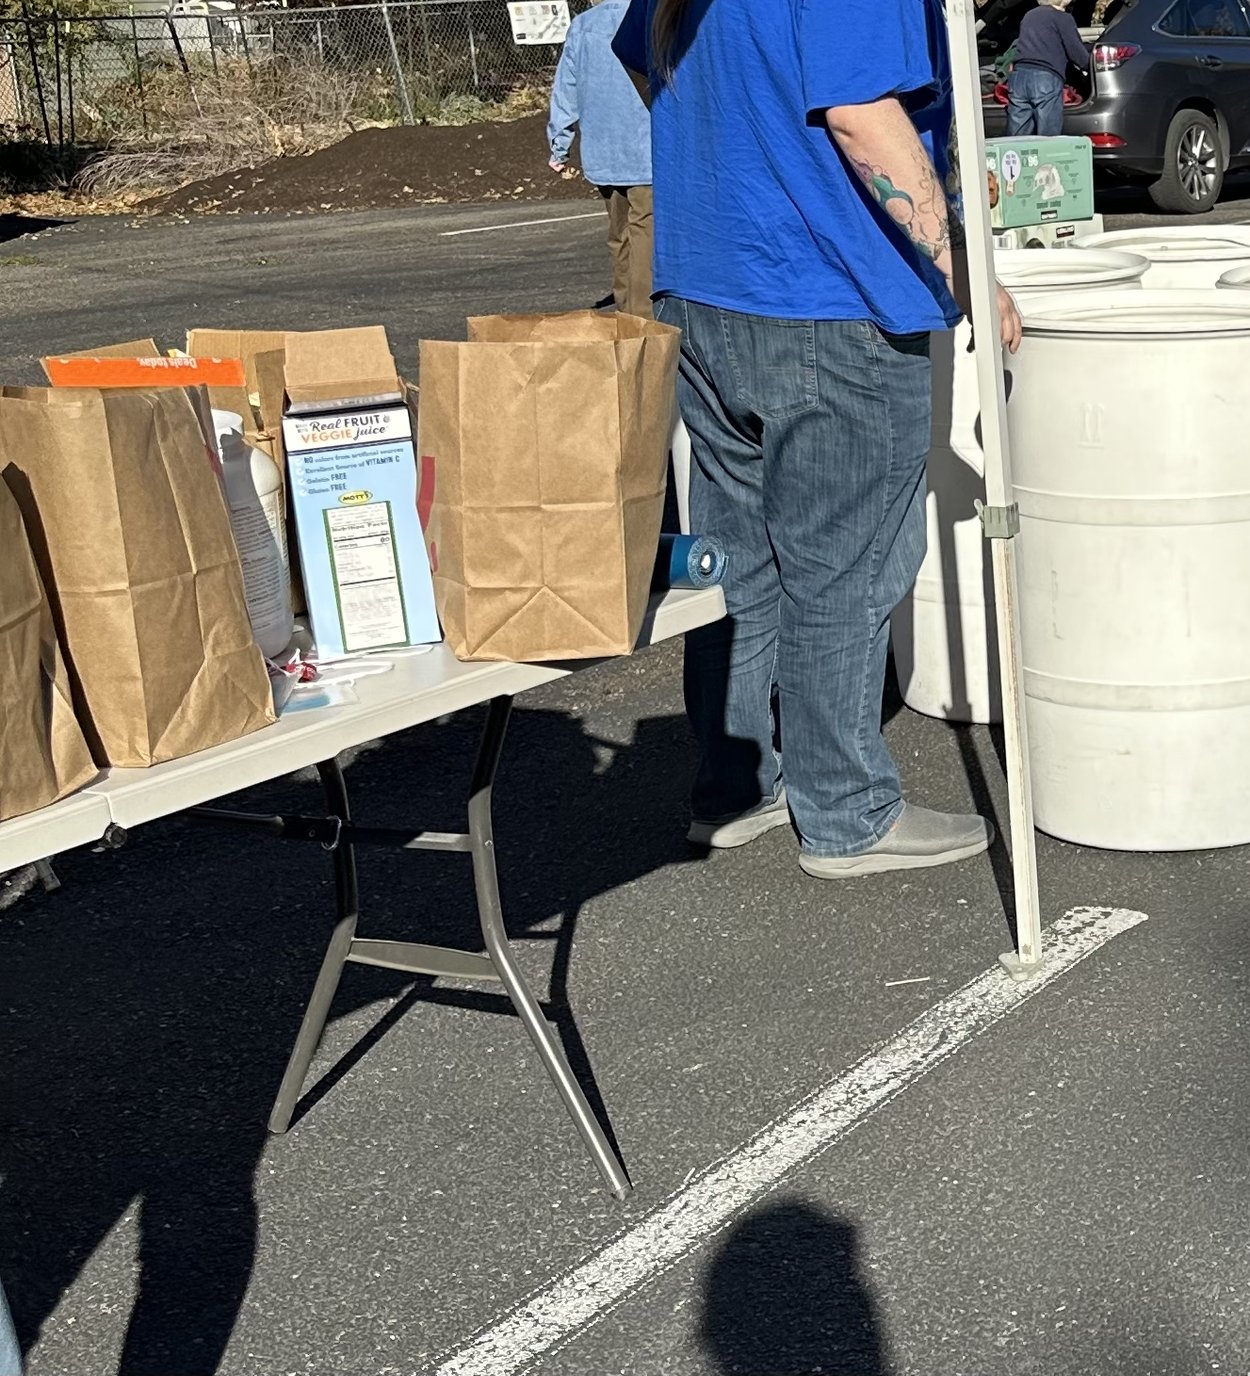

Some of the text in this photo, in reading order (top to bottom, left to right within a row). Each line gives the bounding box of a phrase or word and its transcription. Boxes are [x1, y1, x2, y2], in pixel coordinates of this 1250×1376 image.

[309, 417, 342, 432] Real
[344, 414, 380, 428] FRUIT
[301, 428, 353, 444] VEGGIE
[353, 425, 386, 441] juice
[365, 456, 393, 466] VITAMIN
[330, 472, 347, 481] FREE
[330, 483, 347, 492] FREE
